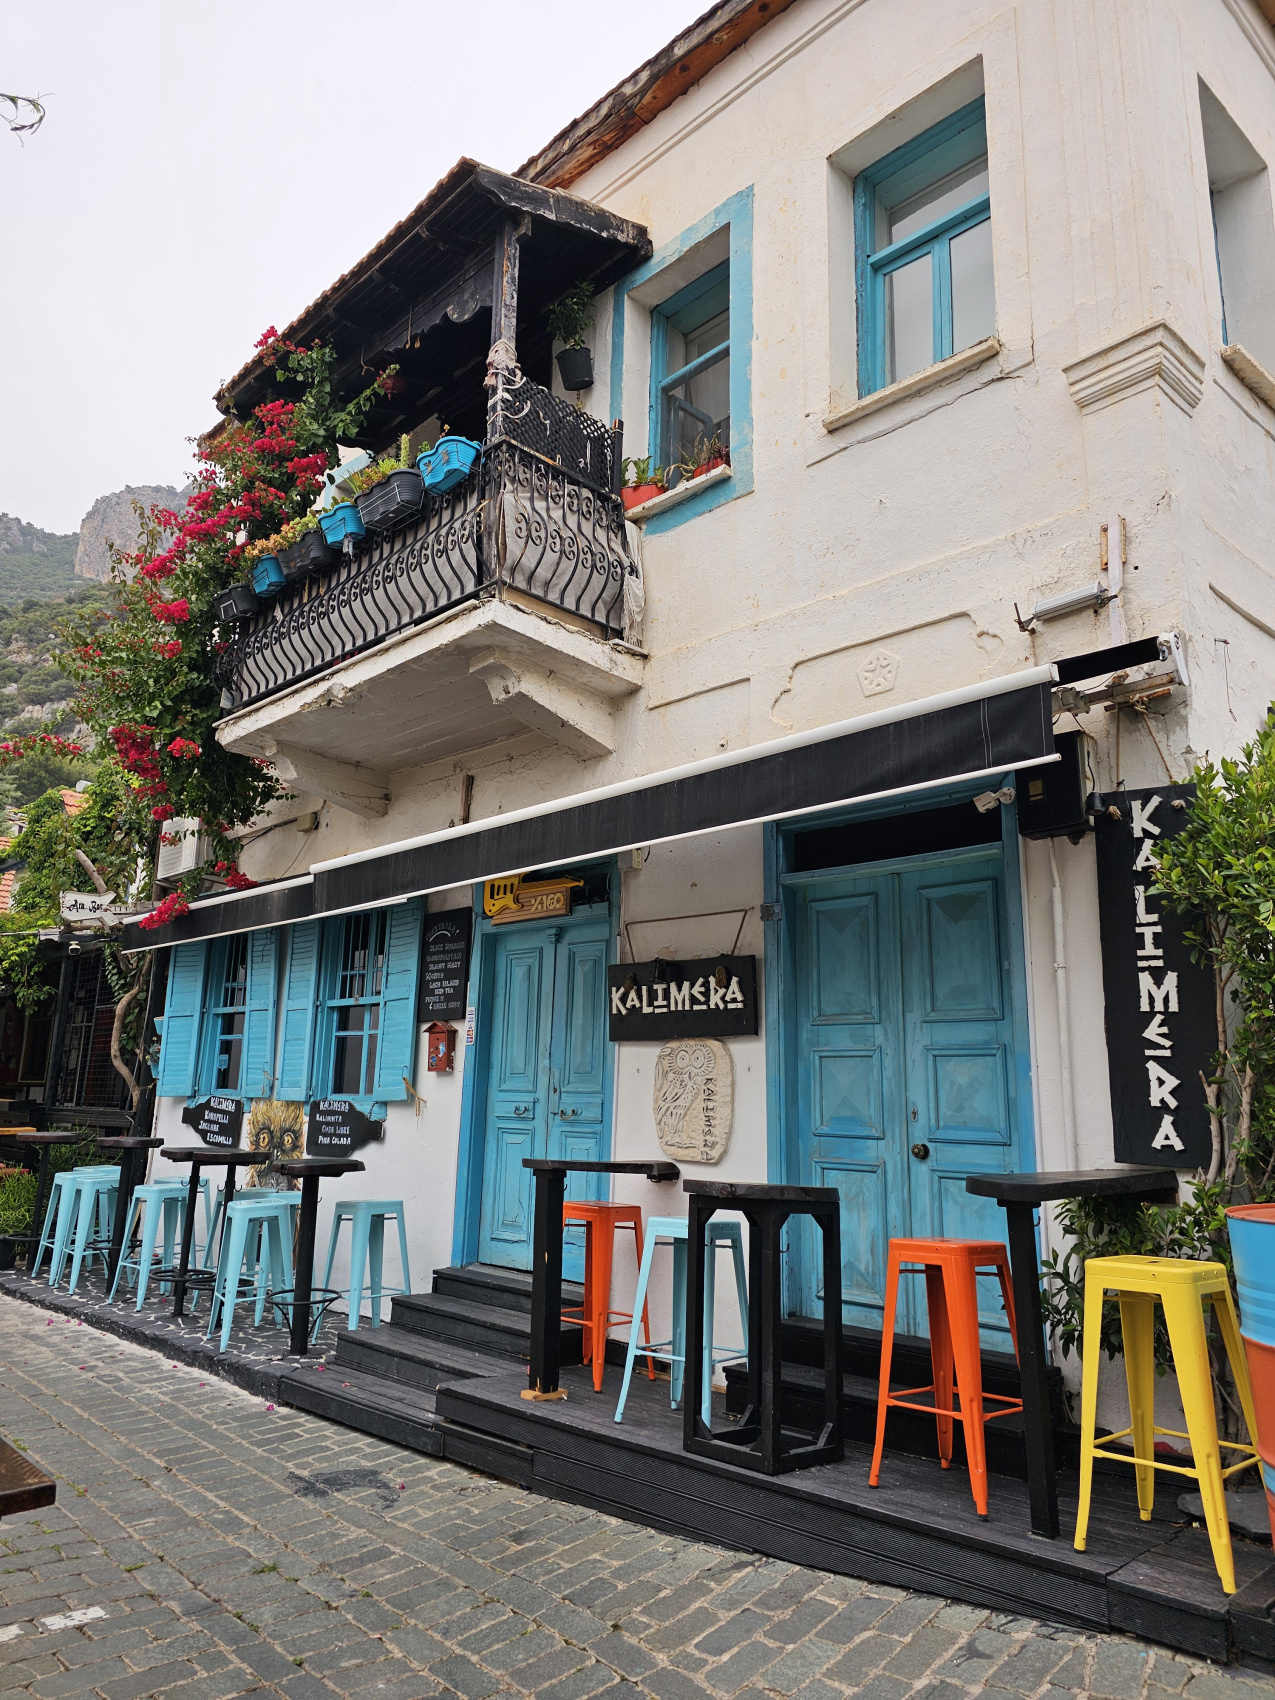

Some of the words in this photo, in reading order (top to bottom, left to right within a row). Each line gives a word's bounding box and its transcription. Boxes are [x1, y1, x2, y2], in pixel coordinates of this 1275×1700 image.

[1130, 795, 1187, 1152] KALIMERA
[611, 975, 745, 1016] KALIMERA
[211, 1097, 235, 1112] KALIMERA
[320, 1101, 349, 1112] KALIMERA
[702, 1077, 718, 1161] KALIMERA
